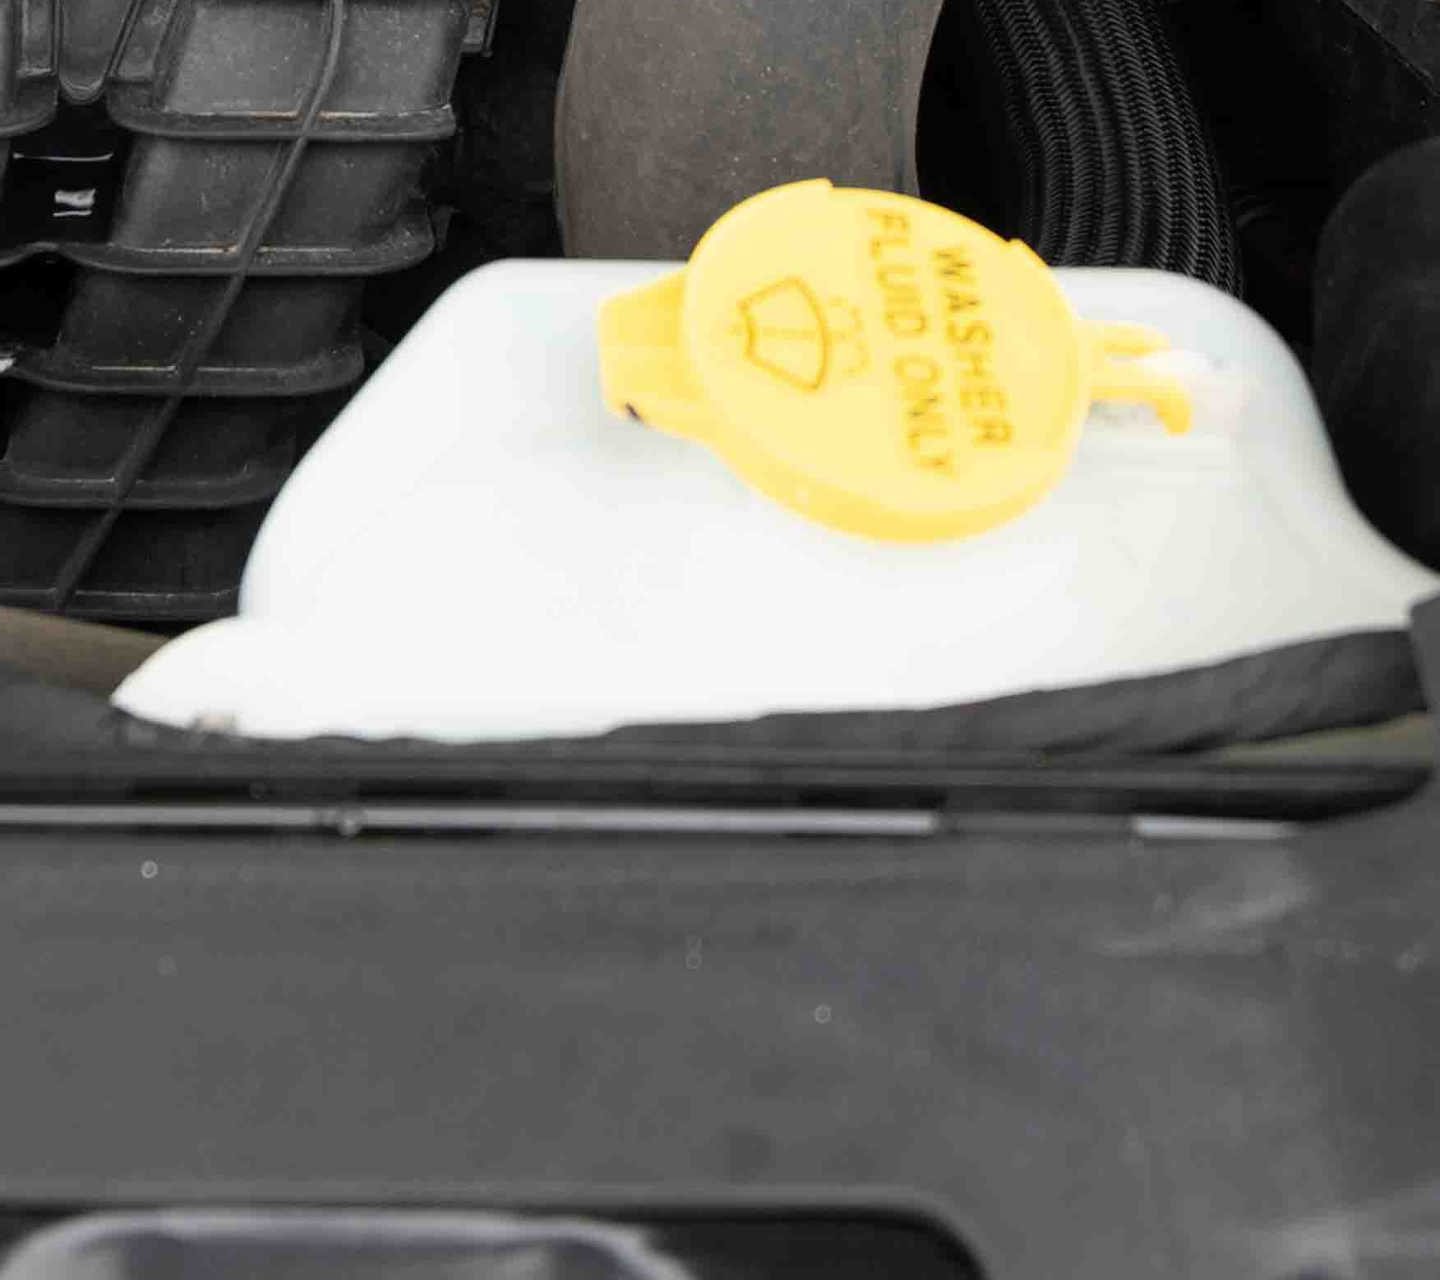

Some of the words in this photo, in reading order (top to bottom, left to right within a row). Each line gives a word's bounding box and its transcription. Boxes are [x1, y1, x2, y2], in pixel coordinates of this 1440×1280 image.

[868, 208, 927, 336] FLUID
[933, 246, 1014, 450] WASHER
[893, 354, 957, 479] ONLY
